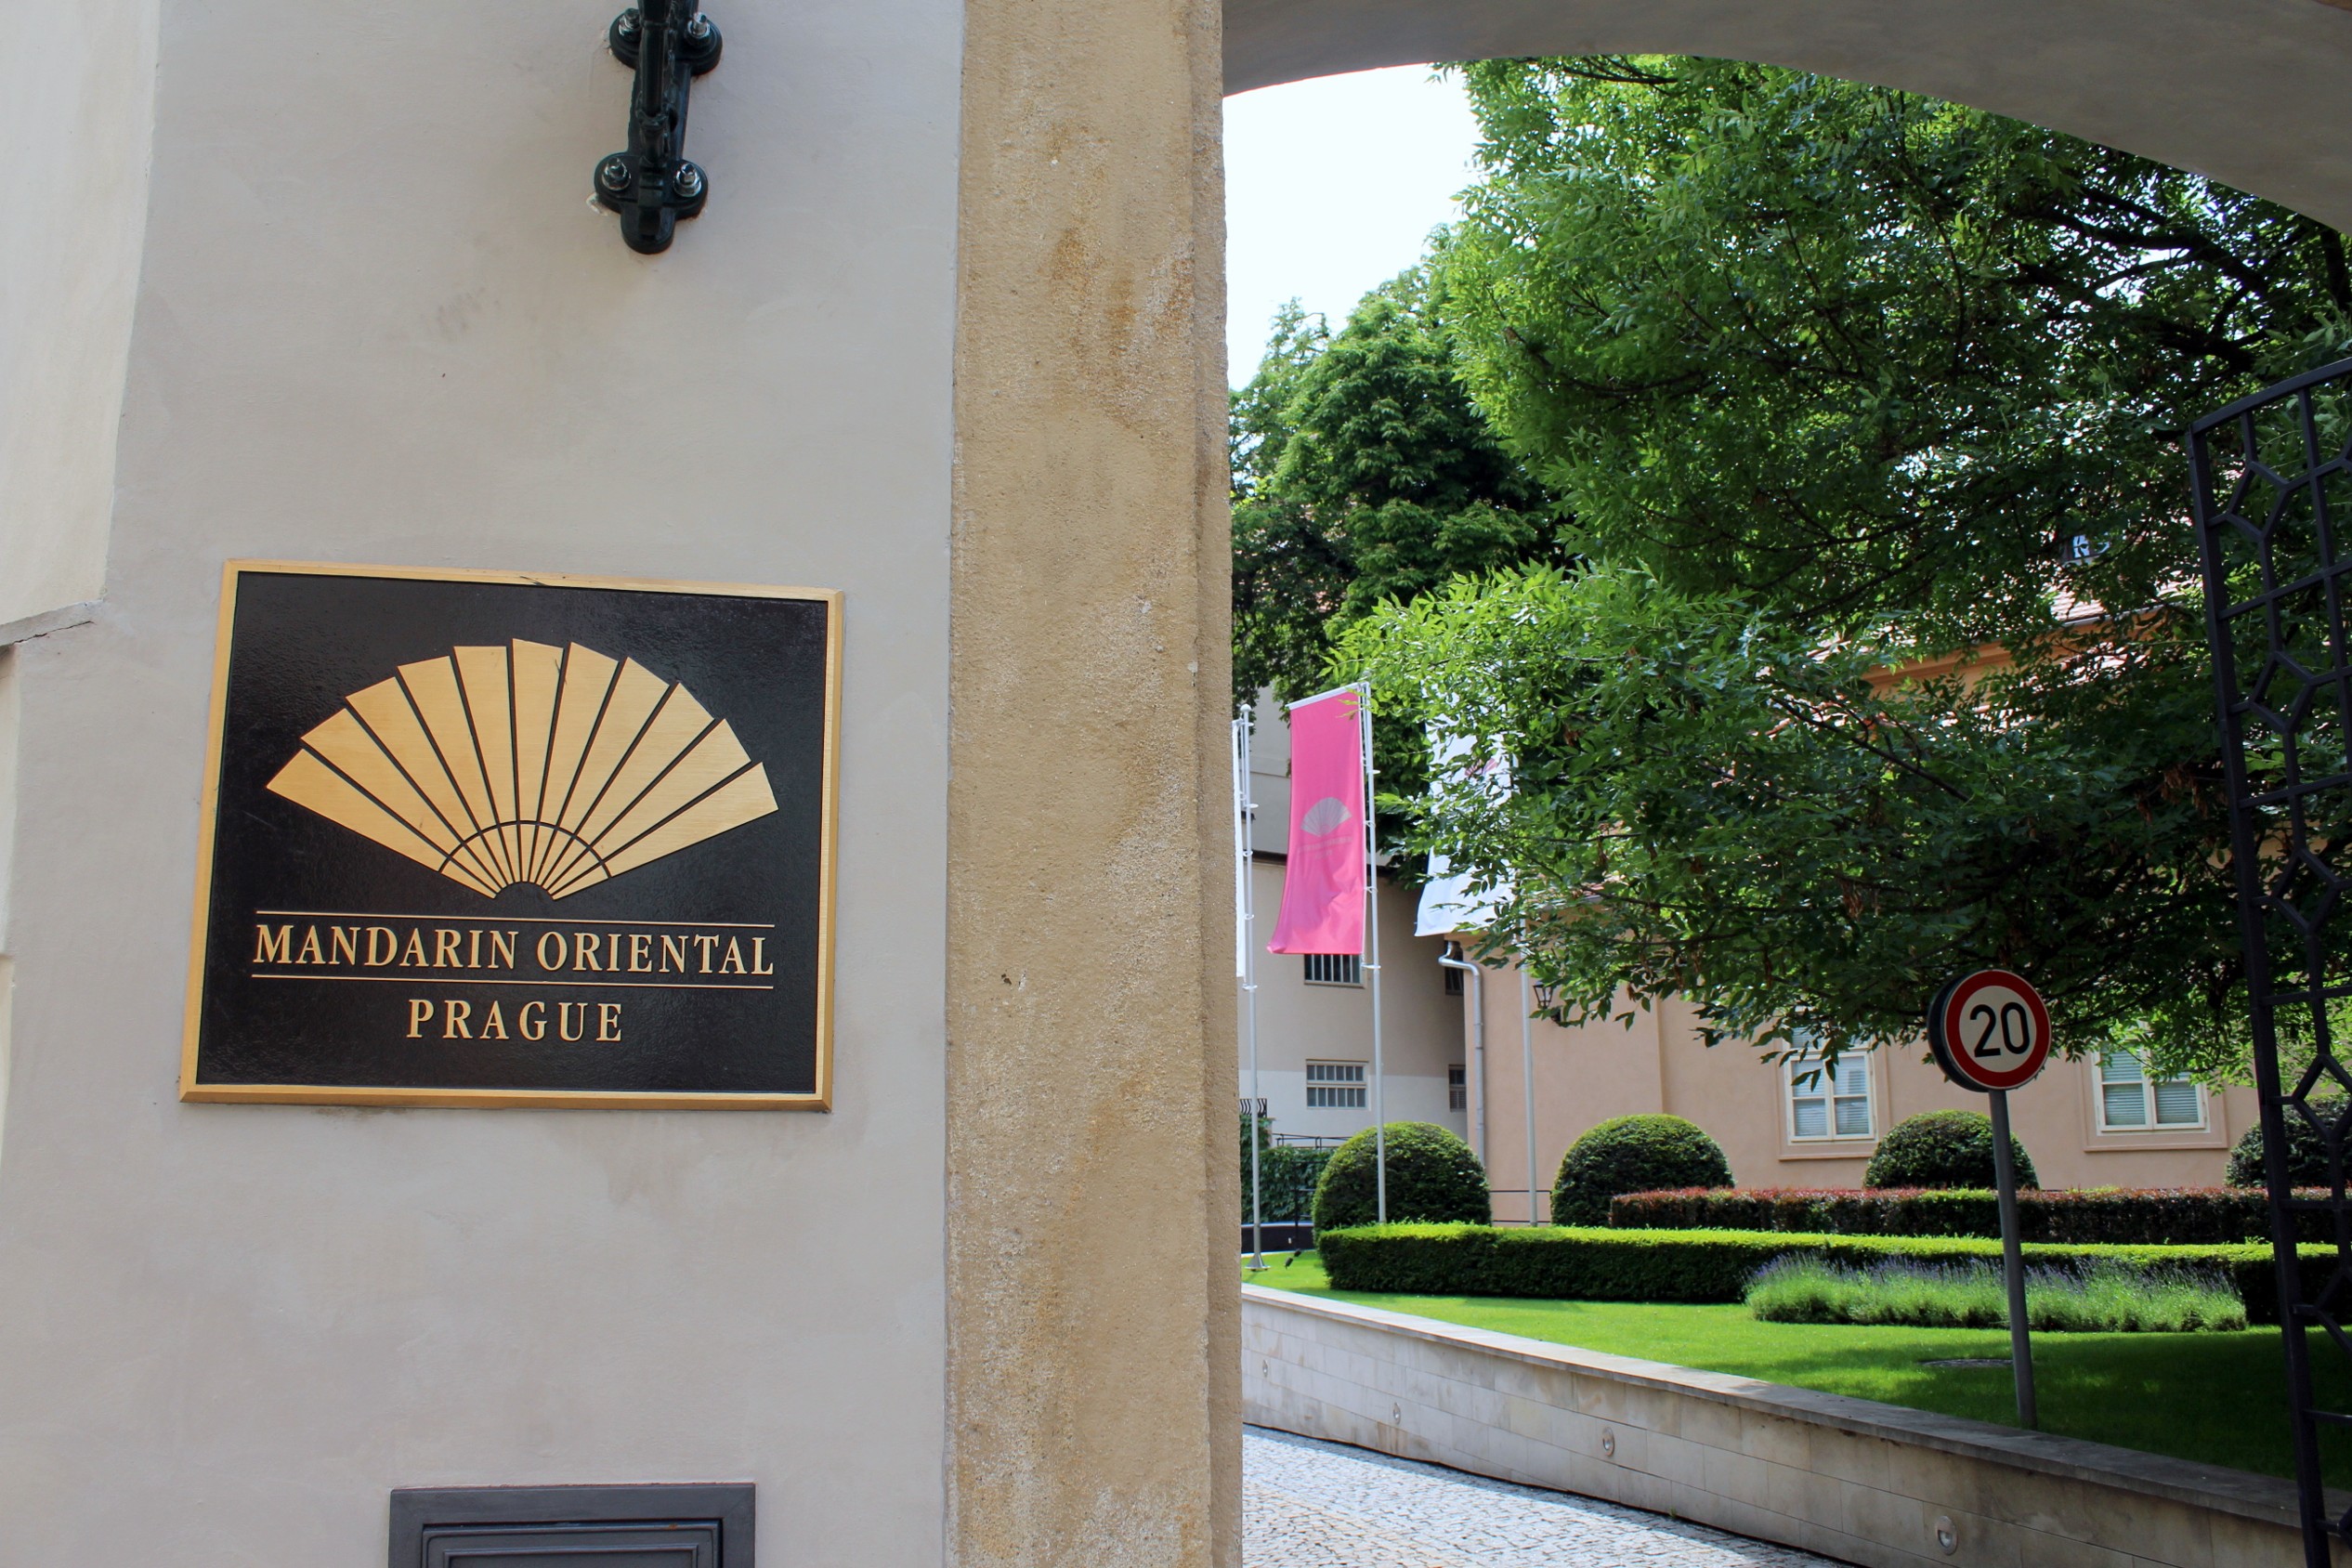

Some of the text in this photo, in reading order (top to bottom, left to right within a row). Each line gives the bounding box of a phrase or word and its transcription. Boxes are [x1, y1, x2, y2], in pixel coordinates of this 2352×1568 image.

[253, 925, 774, 975] MANDARIN ORIENTAL
[406, 999, 621, 1041] PRAGUE
[1969, 1001, 2031, 1057] 20
